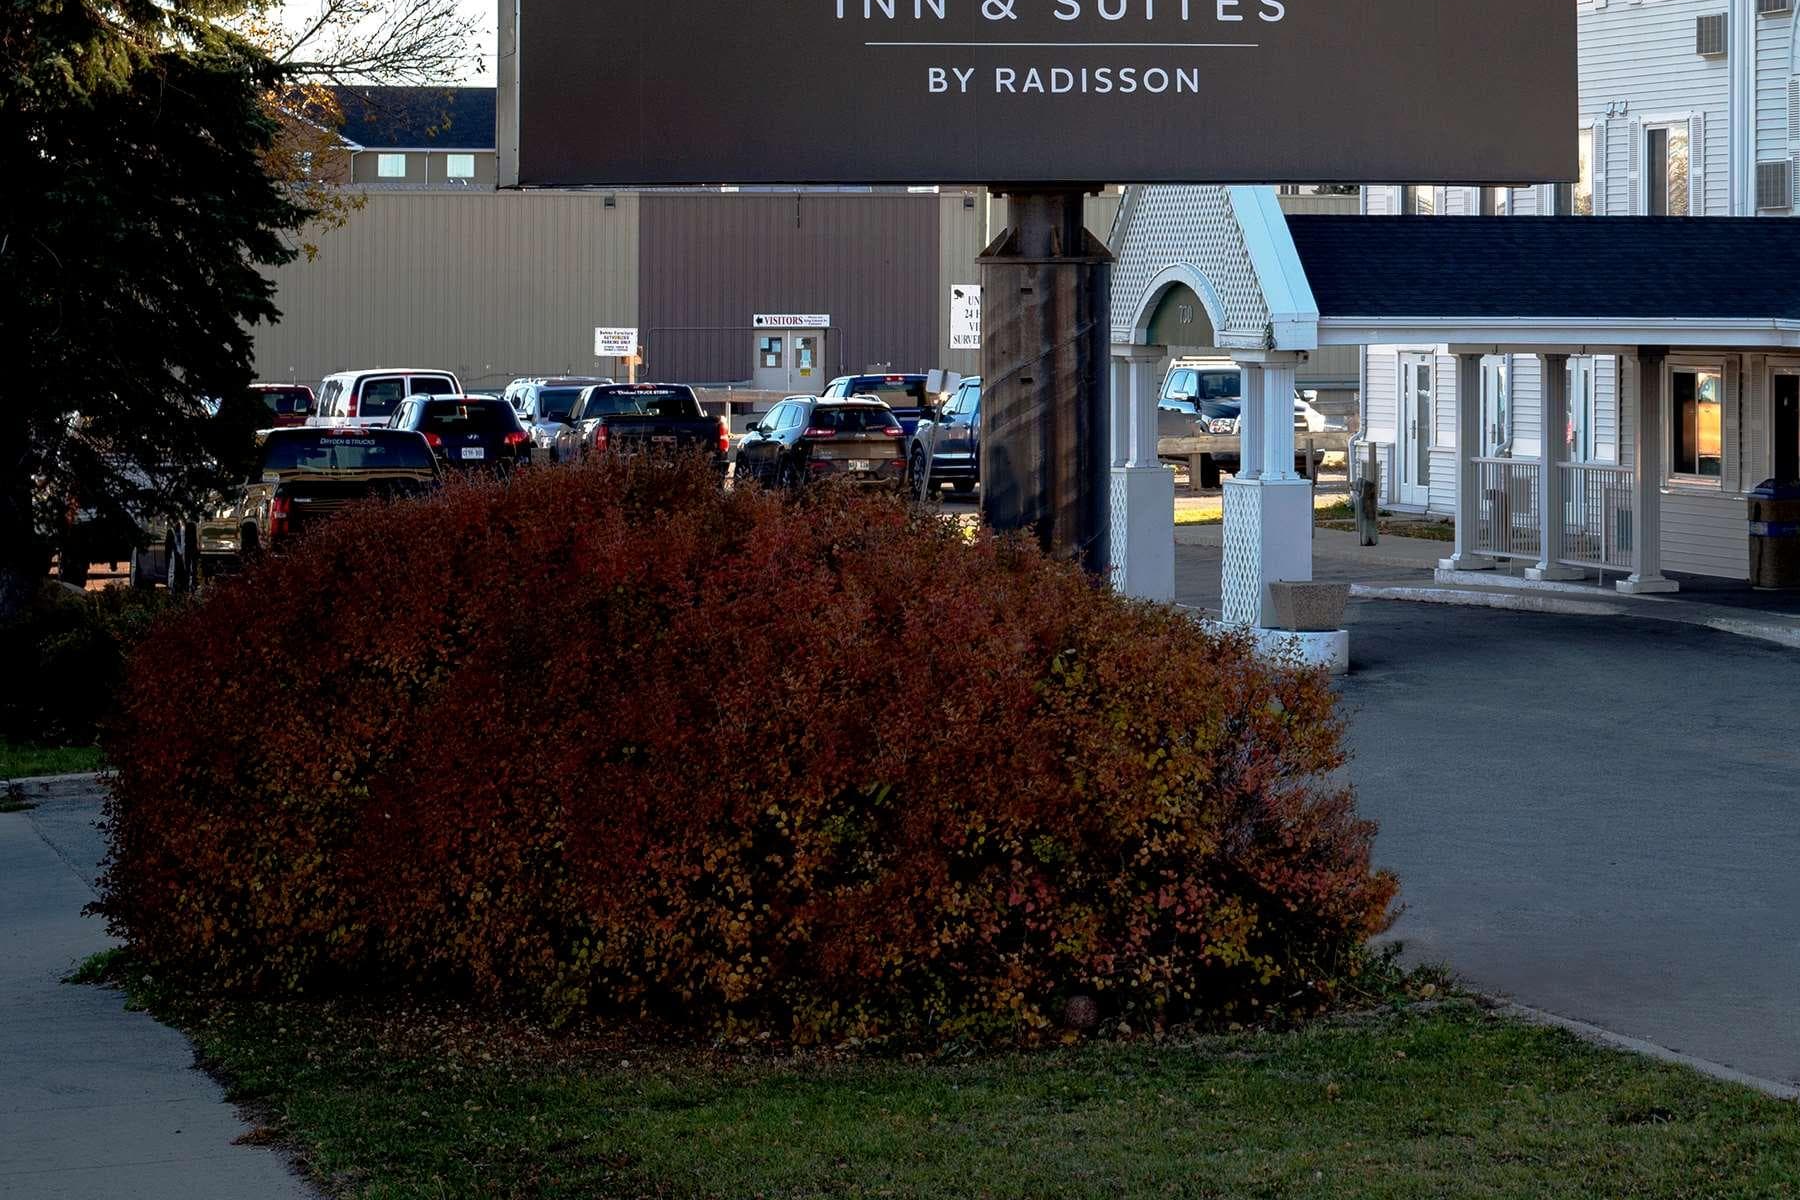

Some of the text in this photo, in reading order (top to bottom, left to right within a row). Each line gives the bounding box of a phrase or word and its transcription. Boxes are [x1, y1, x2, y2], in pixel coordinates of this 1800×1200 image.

[928, 67, 1199, 94] BY RADISSON
[964, 308, 973, 319] 24
[764, 316, 803, 326] VISITORS
